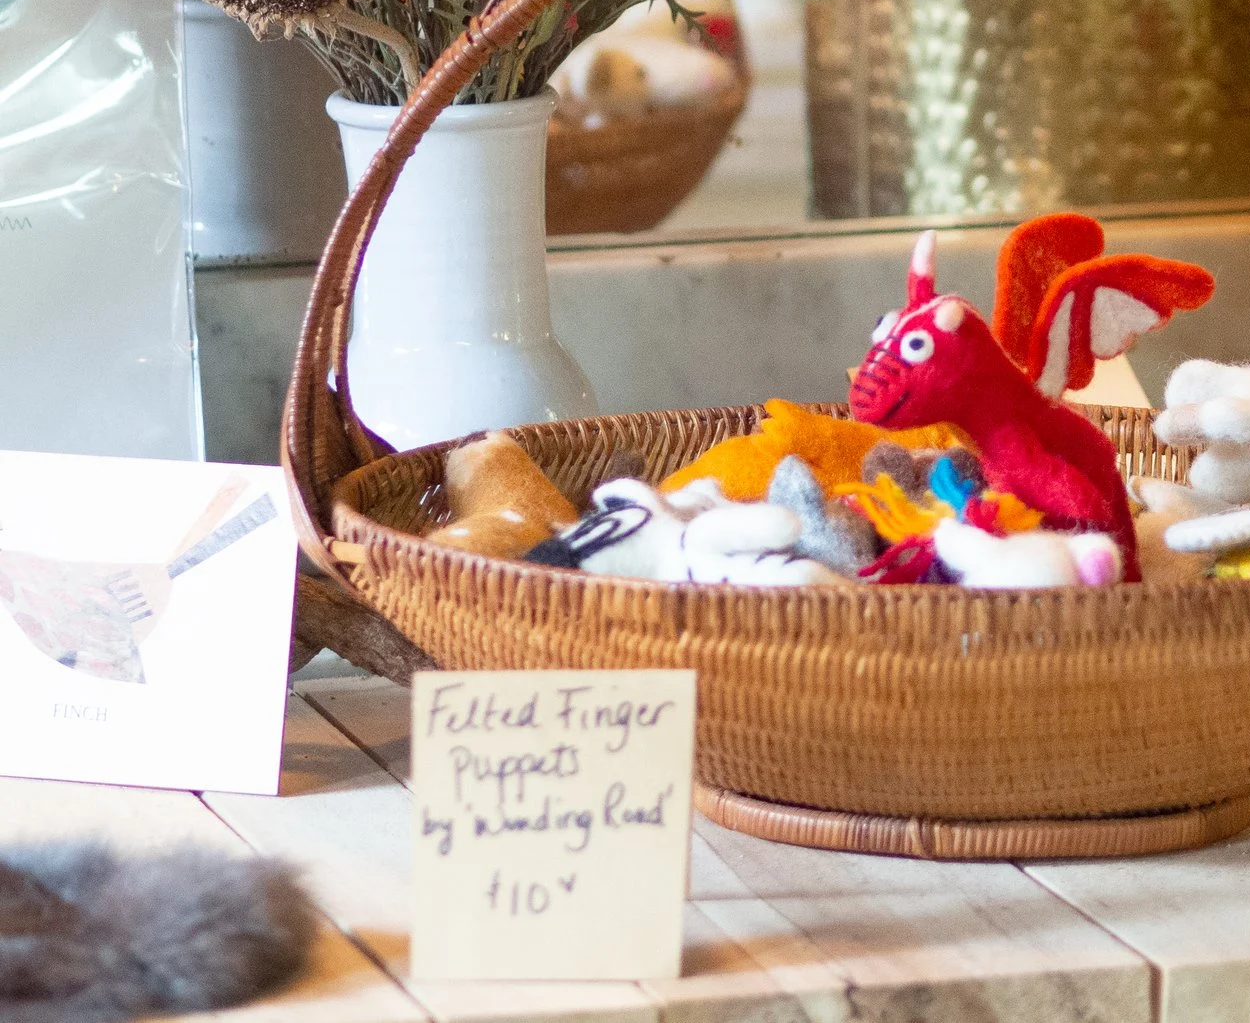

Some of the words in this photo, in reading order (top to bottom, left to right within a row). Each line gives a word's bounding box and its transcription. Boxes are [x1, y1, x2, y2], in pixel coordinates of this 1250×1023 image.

[52, 702, 109, 723] FINCH
[427, 682, 540, 738] Felted
[556, 685, 677, 754] Finger
[420, 805, 454, 856] by
